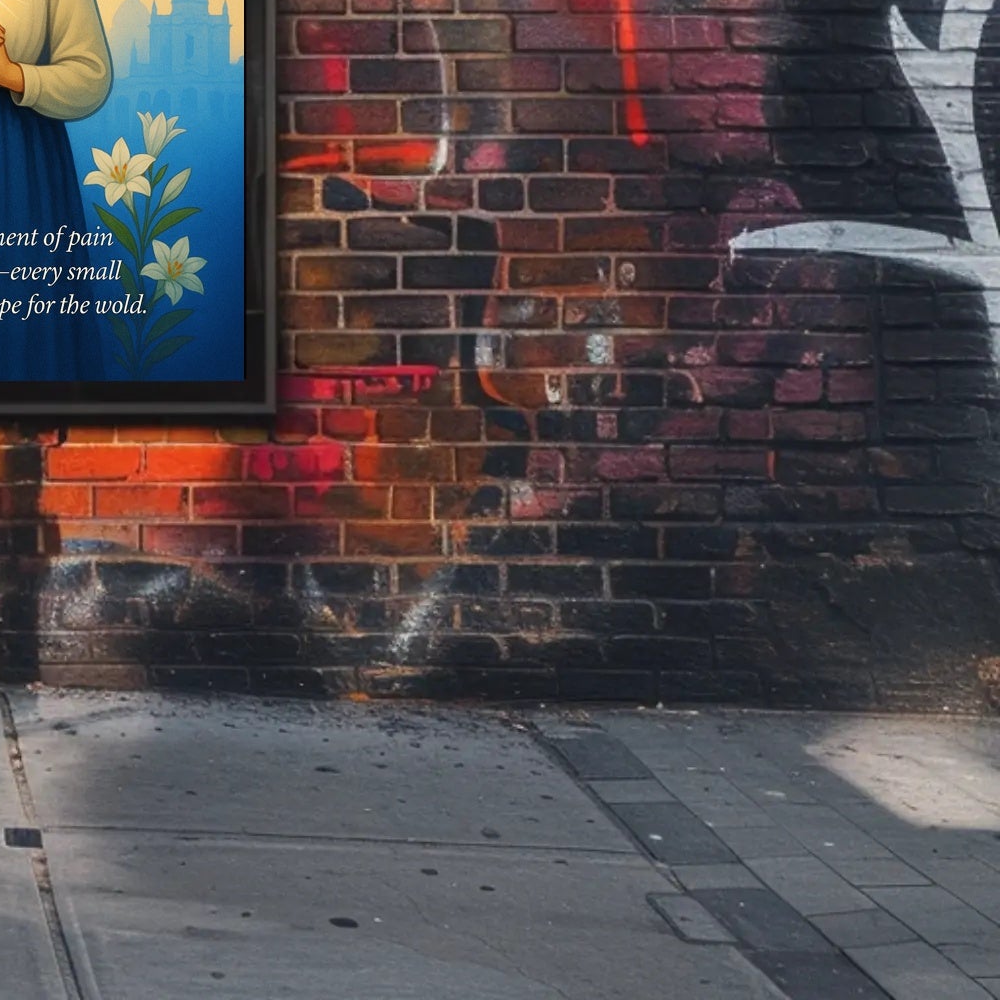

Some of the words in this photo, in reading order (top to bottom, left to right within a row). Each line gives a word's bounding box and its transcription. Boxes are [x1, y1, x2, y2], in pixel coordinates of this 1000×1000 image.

[43, 225, 66, 252] of
[66, 225, 114, 252] pain
[67, 259, 122, 281] small
[21, 294, 56, 320] for
[59, 294, 88, 315] the
[95, 294, 148, 315] wold.
